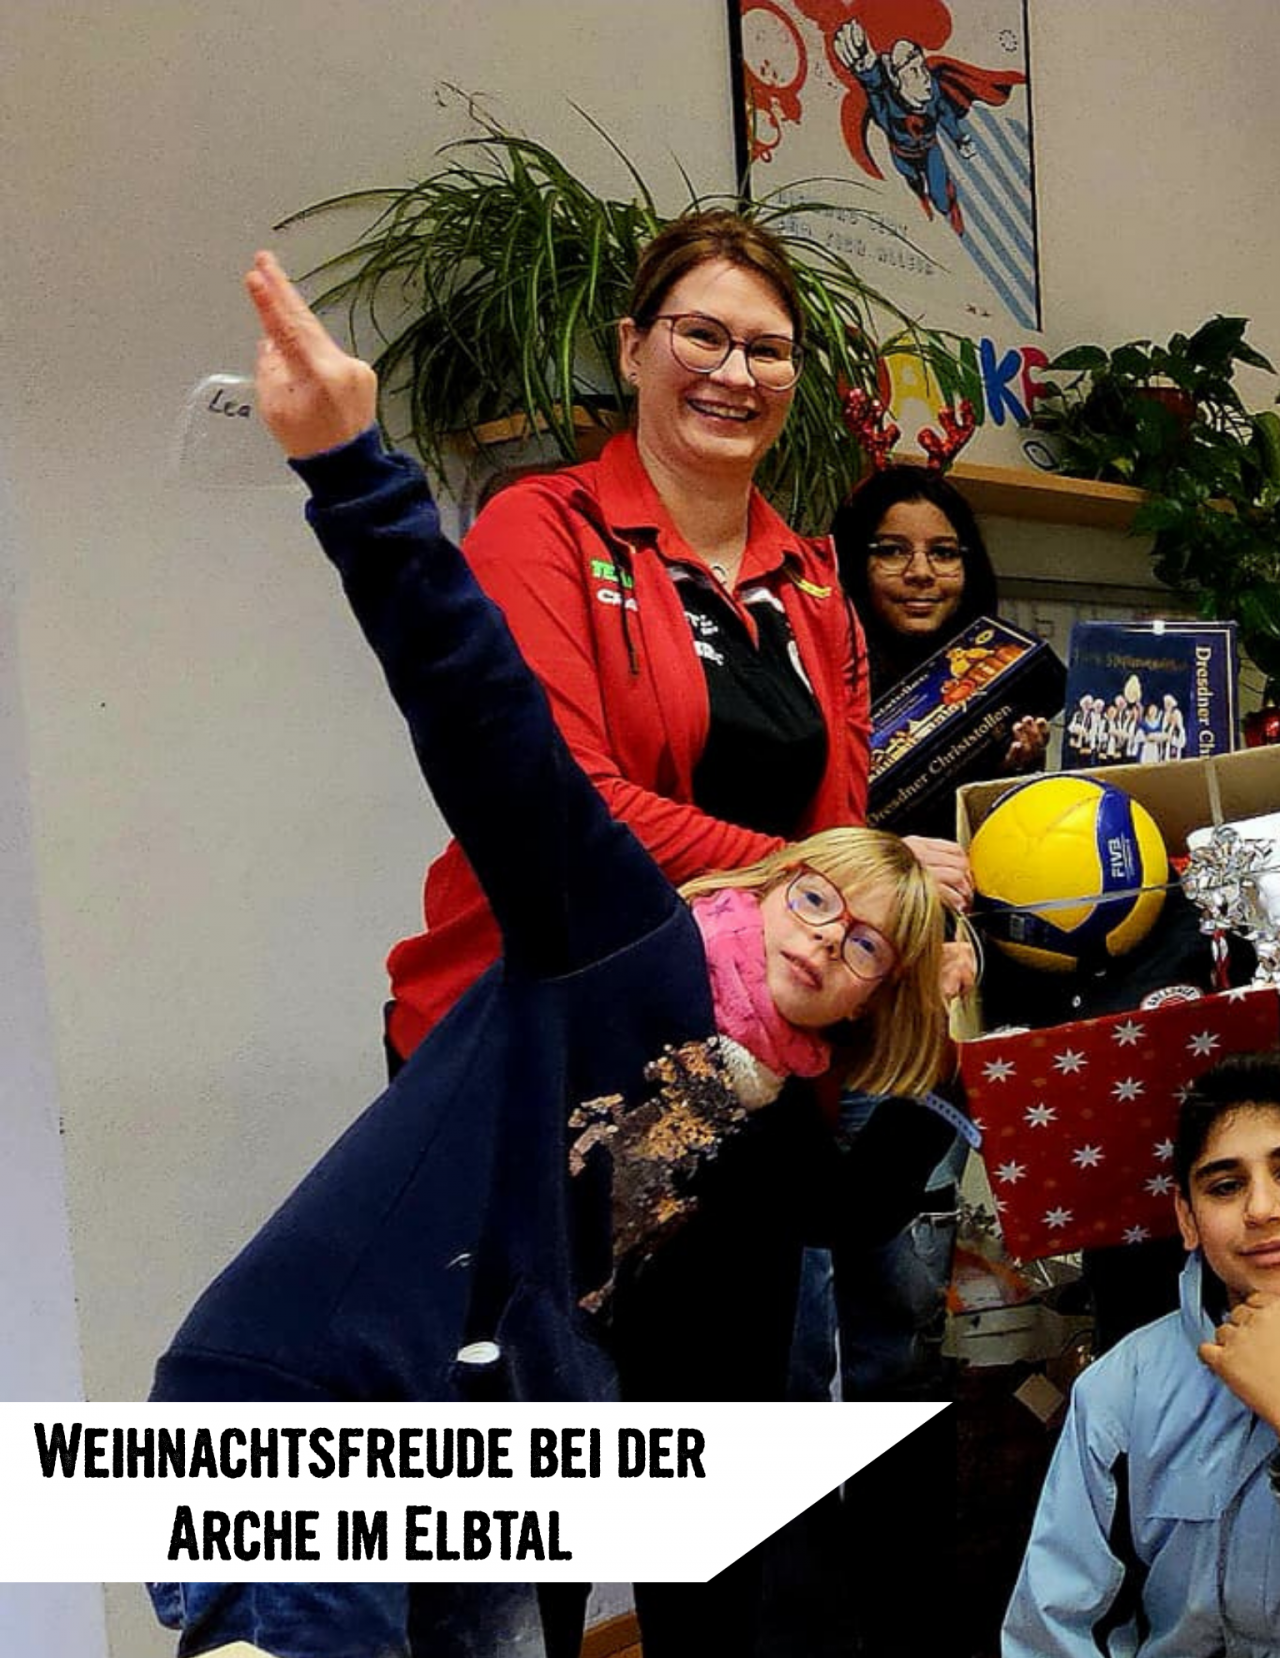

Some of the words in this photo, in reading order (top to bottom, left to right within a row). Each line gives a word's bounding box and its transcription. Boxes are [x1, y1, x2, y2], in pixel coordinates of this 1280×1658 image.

[208, 388, 251, 418] Lea
[1195, 645, 1215, 727] Dresdner
[928, 703, 1013, 776] Christstollen
[1107, 836, 1126, 878] FIVB
